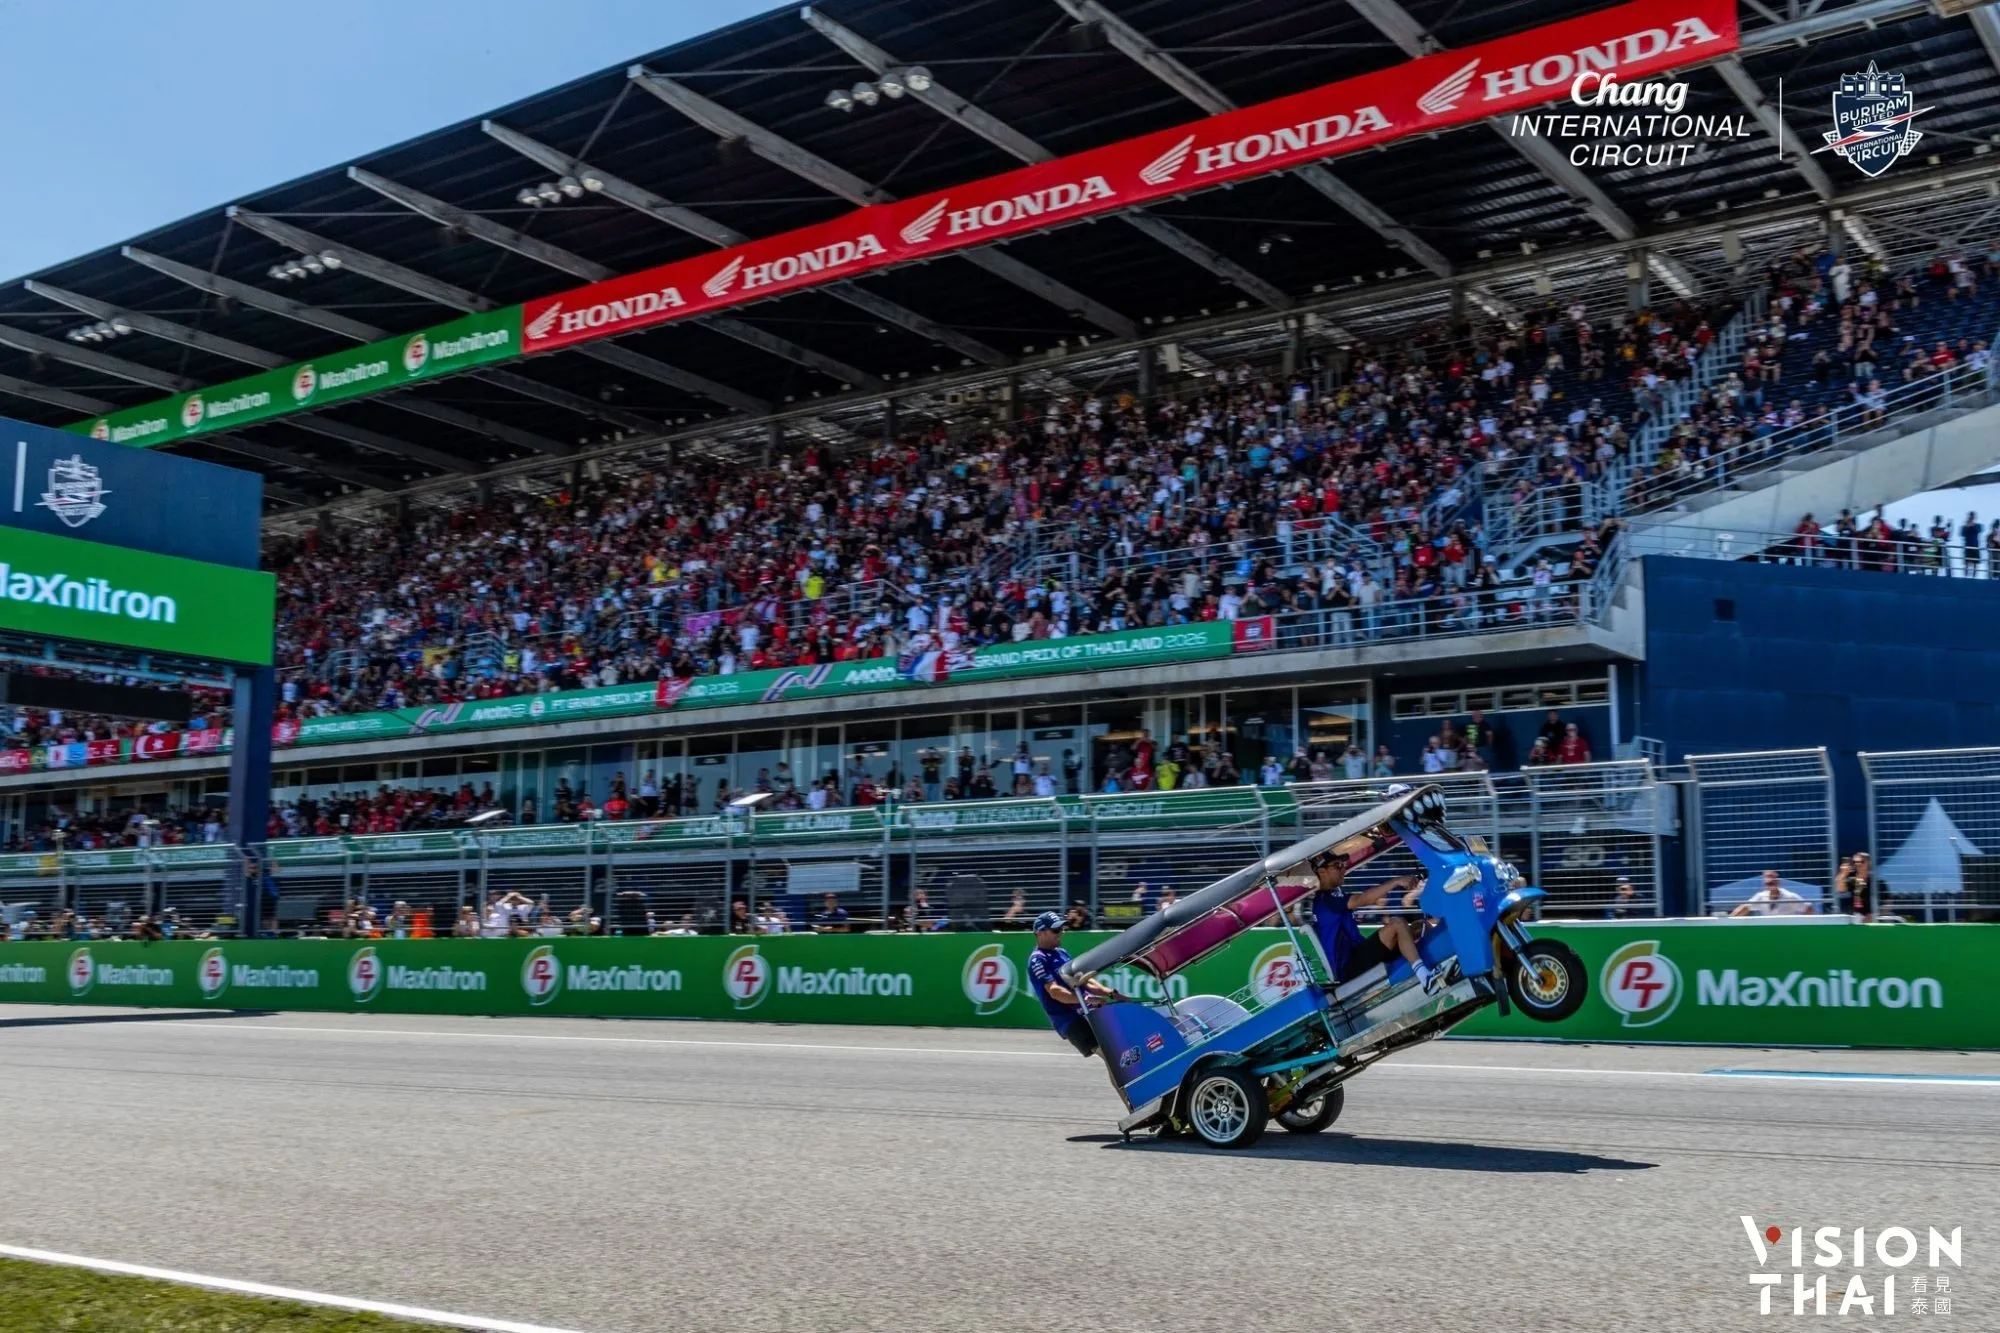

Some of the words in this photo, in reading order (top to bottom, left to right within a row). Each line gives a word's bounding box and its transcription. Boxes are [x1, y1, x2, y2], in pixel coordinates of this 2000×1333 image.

[1481, 17, 1721, 101] HONDA
[1194, 105, 1392, 175] HONDA
[947, 175, 1116, 236] HONDA
[742, 234, 886, 289] HONDA
[559, 287, 686, 333] HONDA
[386, 966, 487, 990] Maxnitron
[567, 965, 682, 991] Maxnitron
[734, 960, 761, 996] PT
[777, 966, 913, 997] Maxnitron
[975, 961, 1006, 1000] PT
[1620, 961, 1664, 1008] PT
[1697, 969, 1943, 1008] Maxnitron
